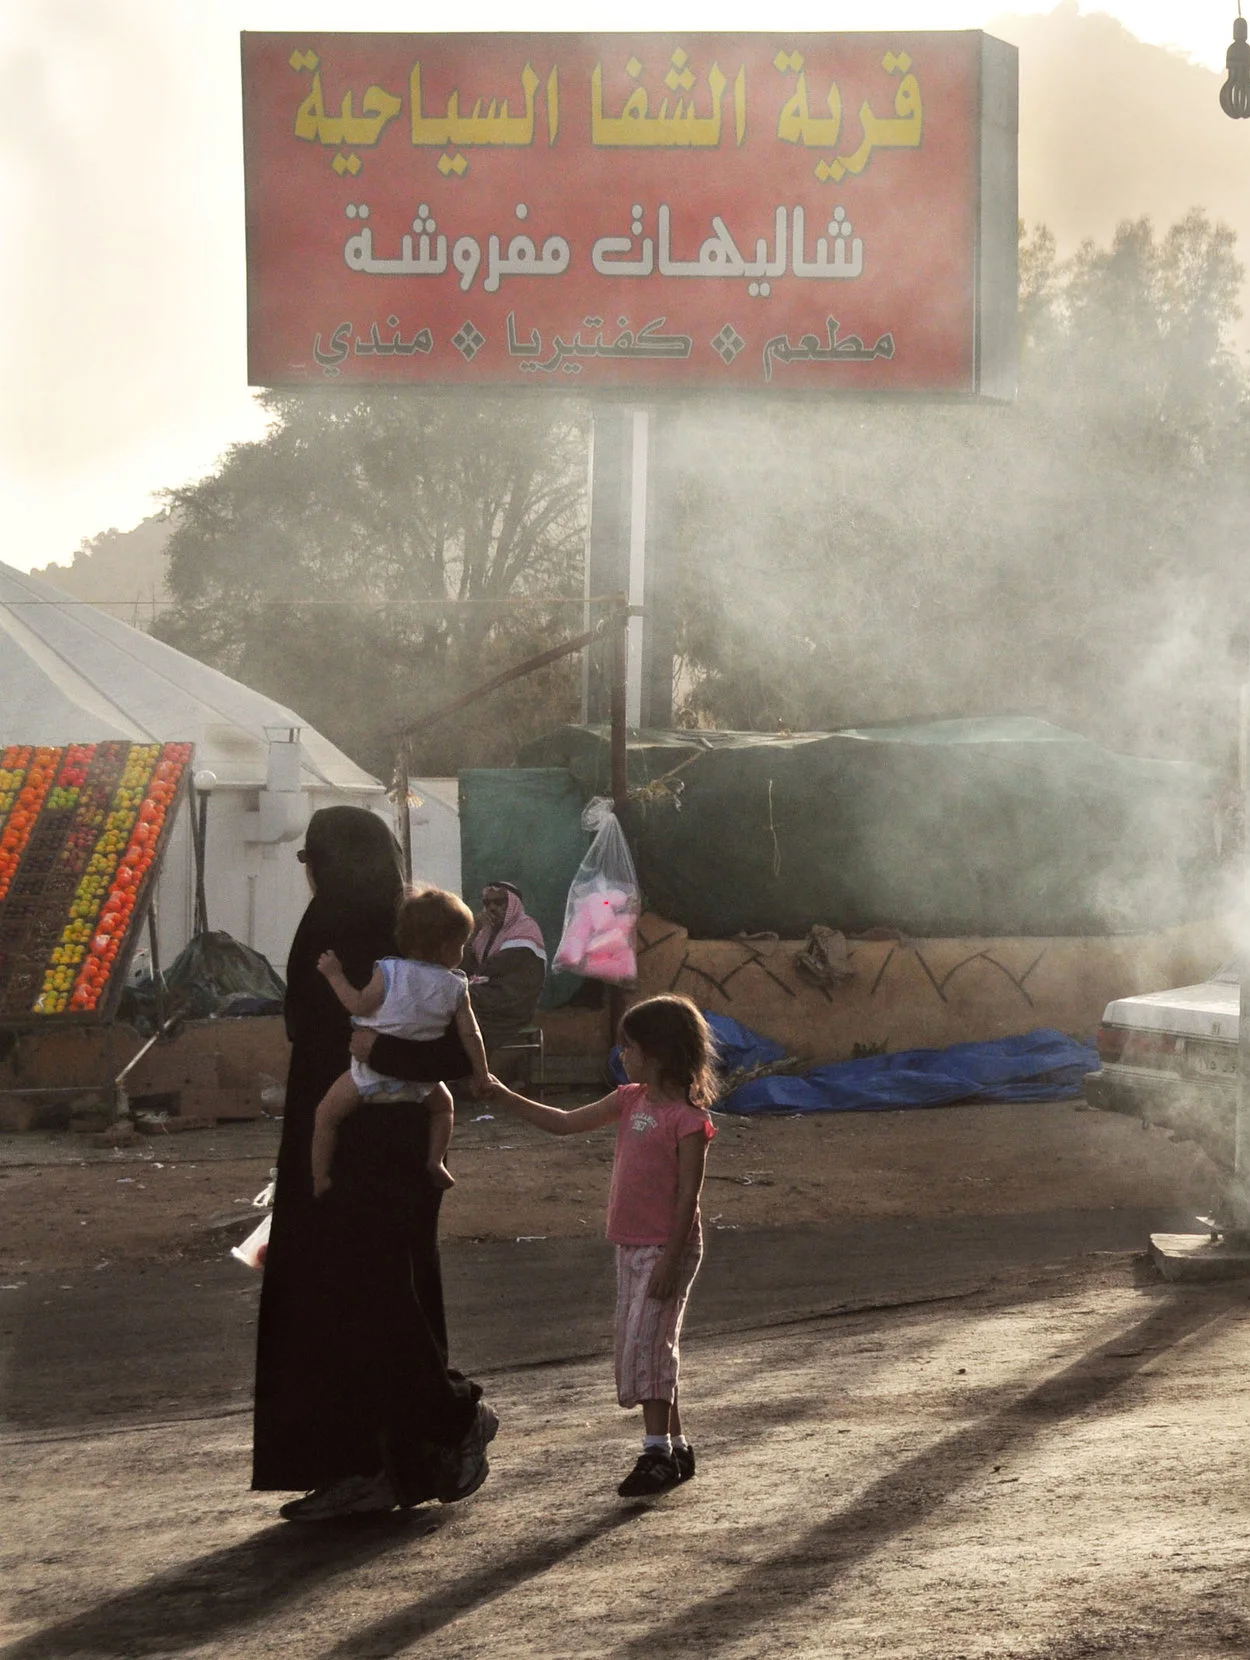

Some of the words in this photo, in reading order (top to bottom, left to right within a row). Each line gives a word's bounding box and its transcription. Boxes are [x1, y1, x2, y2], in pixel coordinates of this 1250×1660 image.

[288, 49, 559, 177] السياحية
[591, 46, 747, 147] الشفا
[773, 49, 923, 184] قرية
[344, 202, 571, 293] مفروشة
[591, 203, 863, 298] شاليهات
[312, 314, 434, 377] مندي
[506, 310, 693, 375] كفتيريا
[762, 314, 896, 383] مطعم
